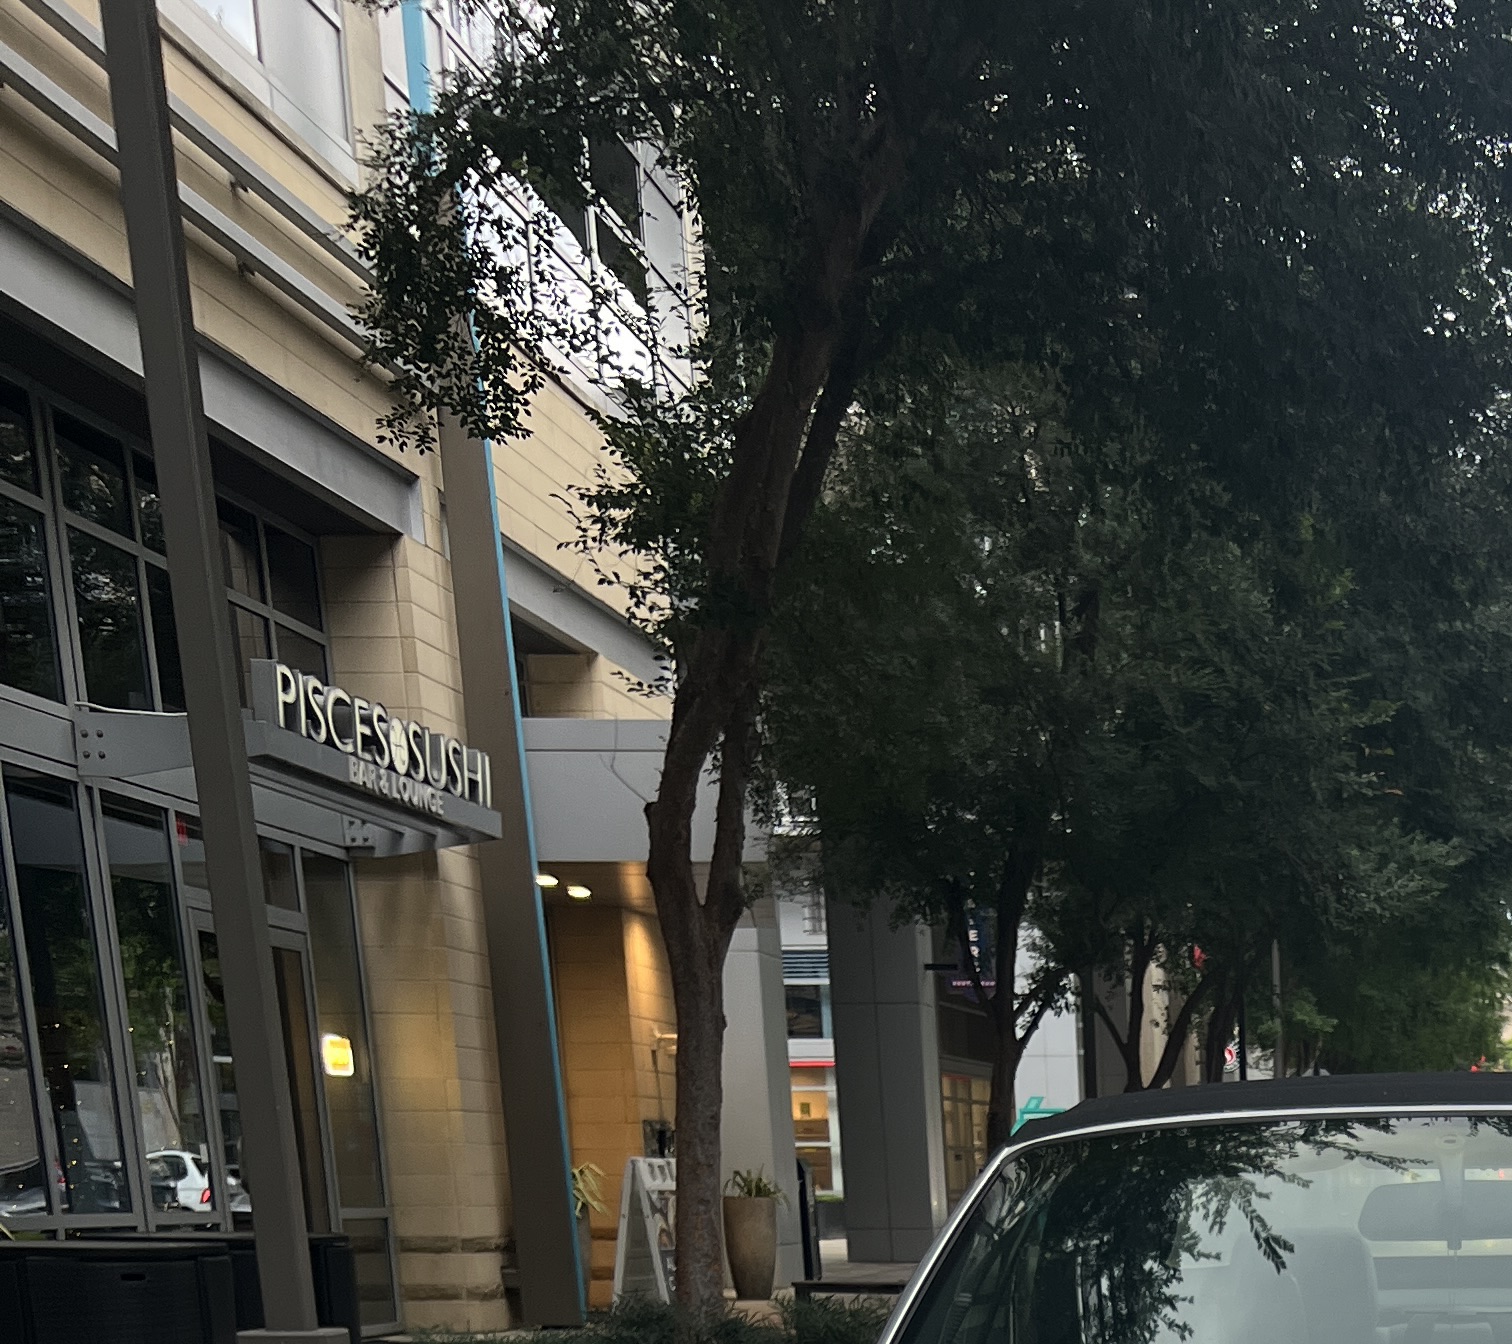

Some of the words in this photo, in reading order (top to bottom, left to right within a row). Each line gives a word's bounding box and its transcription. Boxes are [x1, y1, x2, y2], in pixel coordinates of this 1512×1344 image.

[276, 663, 391, 769] PISCES
[408, 720, 492, 809] SUSHI
[351, 758, 380, 793] BAR
[379, 768, 390, 796] &
[392, 778, 445, 816] LOUNGE
